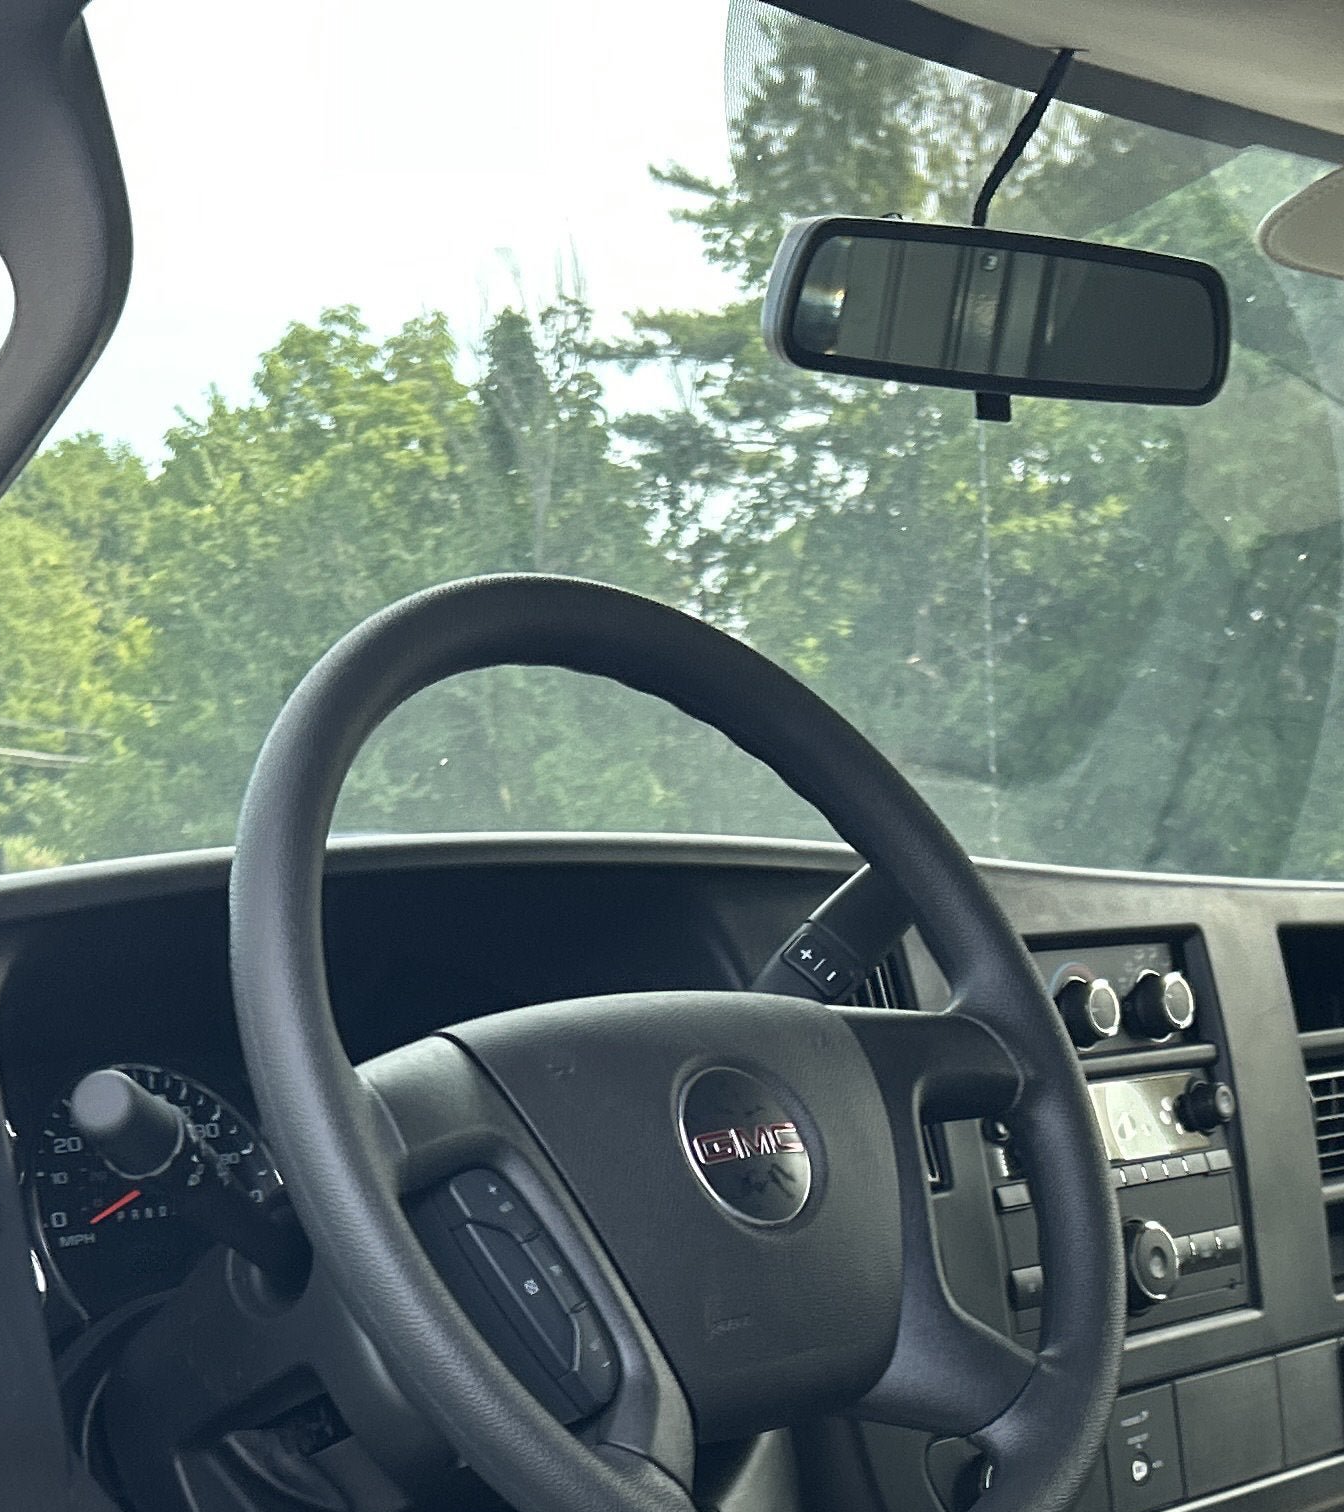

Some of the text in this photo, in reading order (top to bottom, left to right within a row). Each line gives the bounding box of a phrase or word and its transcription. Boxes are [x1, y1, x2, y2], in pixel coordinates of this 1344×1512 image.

[54, 1136, 83, 1154] 20
[693, 1122, 805, 1165] GMC
[52, 1171, 68, 1185] 10
[50, 1211, 67, 1228] 0
[59, 1232, 96, 1248] MPH
